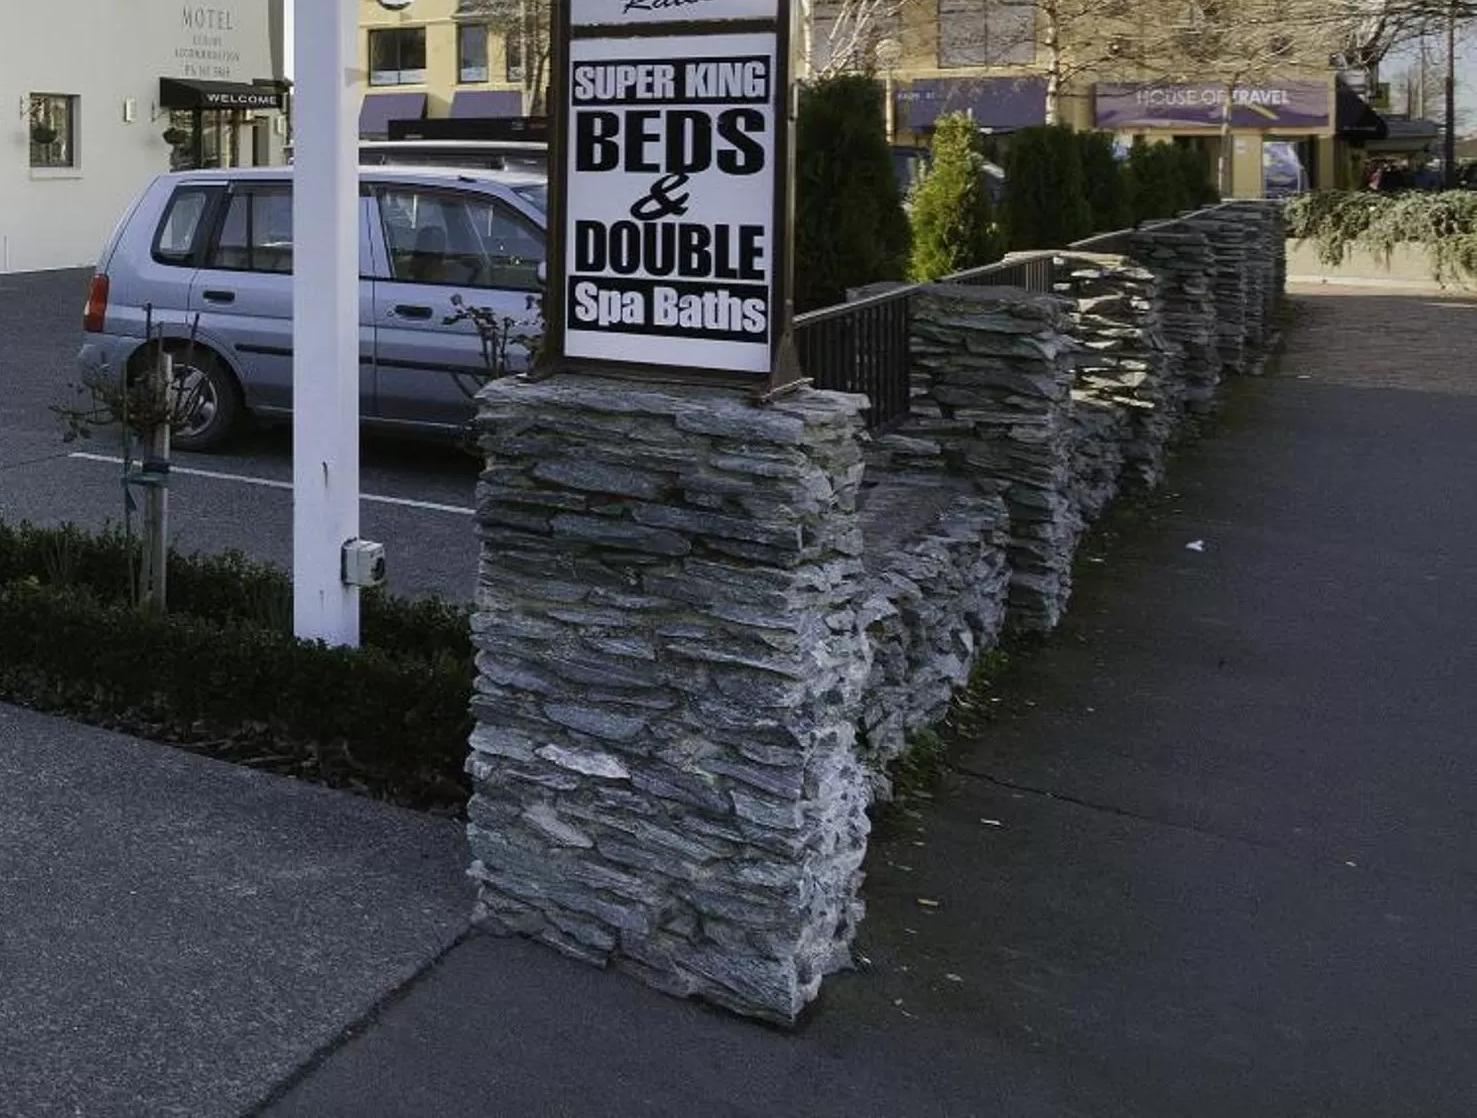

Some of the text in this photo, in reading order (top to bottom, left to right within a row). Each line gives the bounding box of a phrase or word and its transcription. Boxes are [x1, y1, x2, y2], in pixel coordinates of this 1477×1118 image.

[182, 5, 234, 31] MOTEL
[206, 92, 278, 105] WELCOME
[573, 58, 768, 100] SUPER KING
[1136, 88, 1197, 107] HOUSE
[1200, 88, 1225, 106] OF
[574, 107, 766, 176] BEDS
[630, 173, 690, 221] &
[575, 220, 765, 281] DOUBLE
[574, 281, 768, 334] Spa Baths
